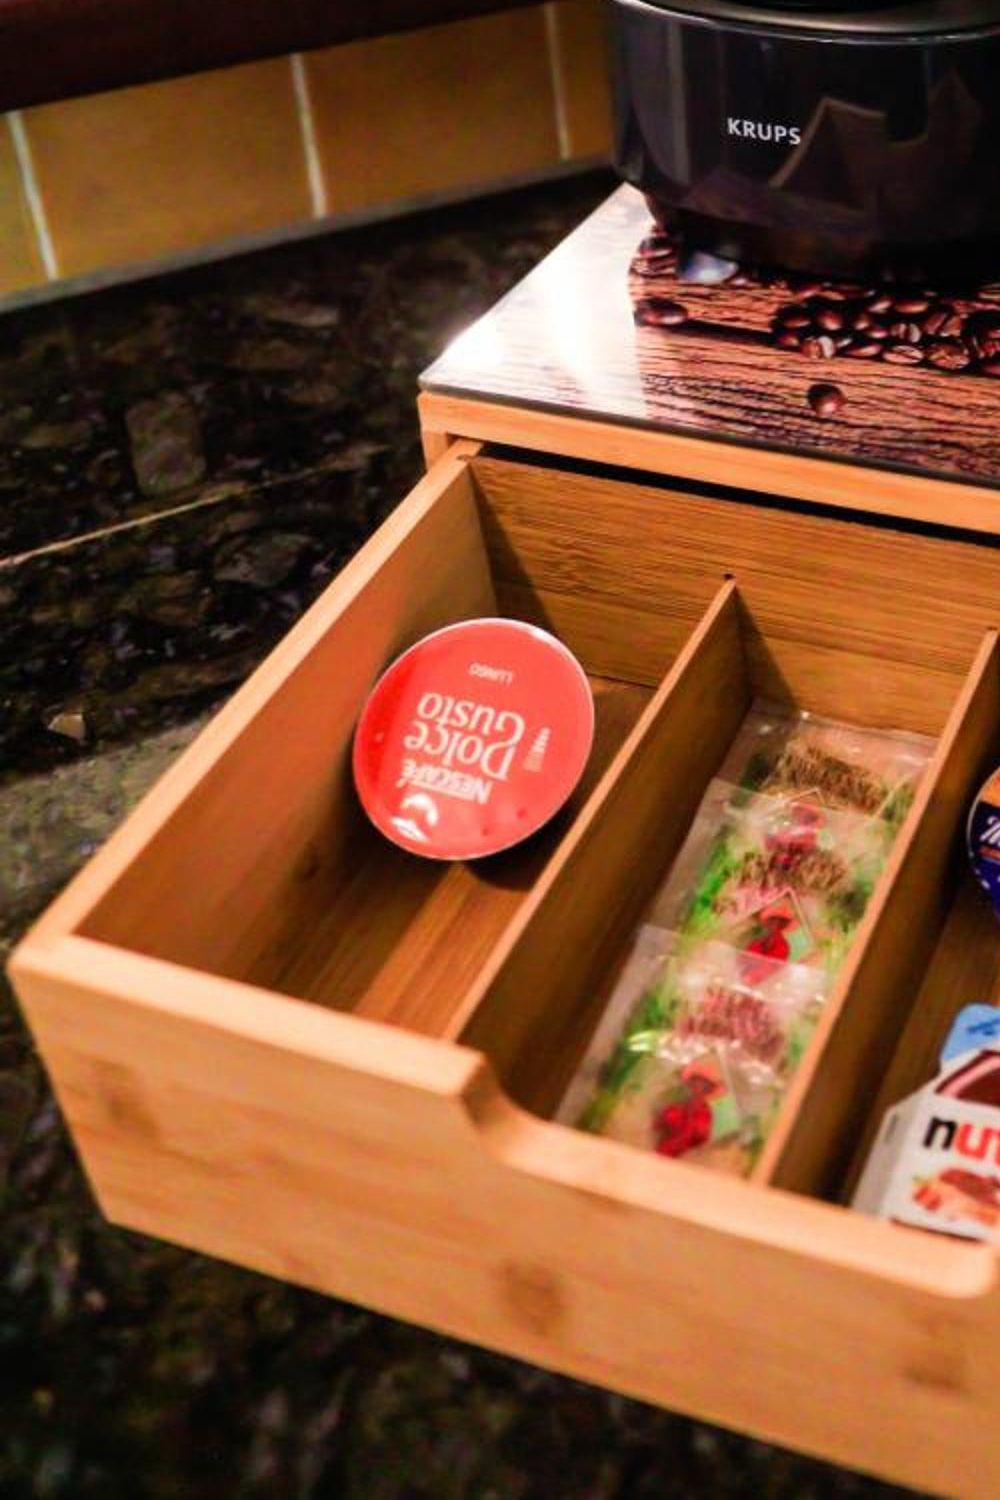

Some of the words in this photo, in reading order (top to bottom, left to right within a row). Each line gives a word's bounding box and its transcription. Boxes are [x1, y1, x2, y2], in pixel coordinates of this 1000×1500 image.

[726, 117, 801, 146] KRUPS
[416, 692, 526, 746] Gusto
[403, 720, 517, 781] Dolce
[395, 758, 493, 805] NESCAFÉ
